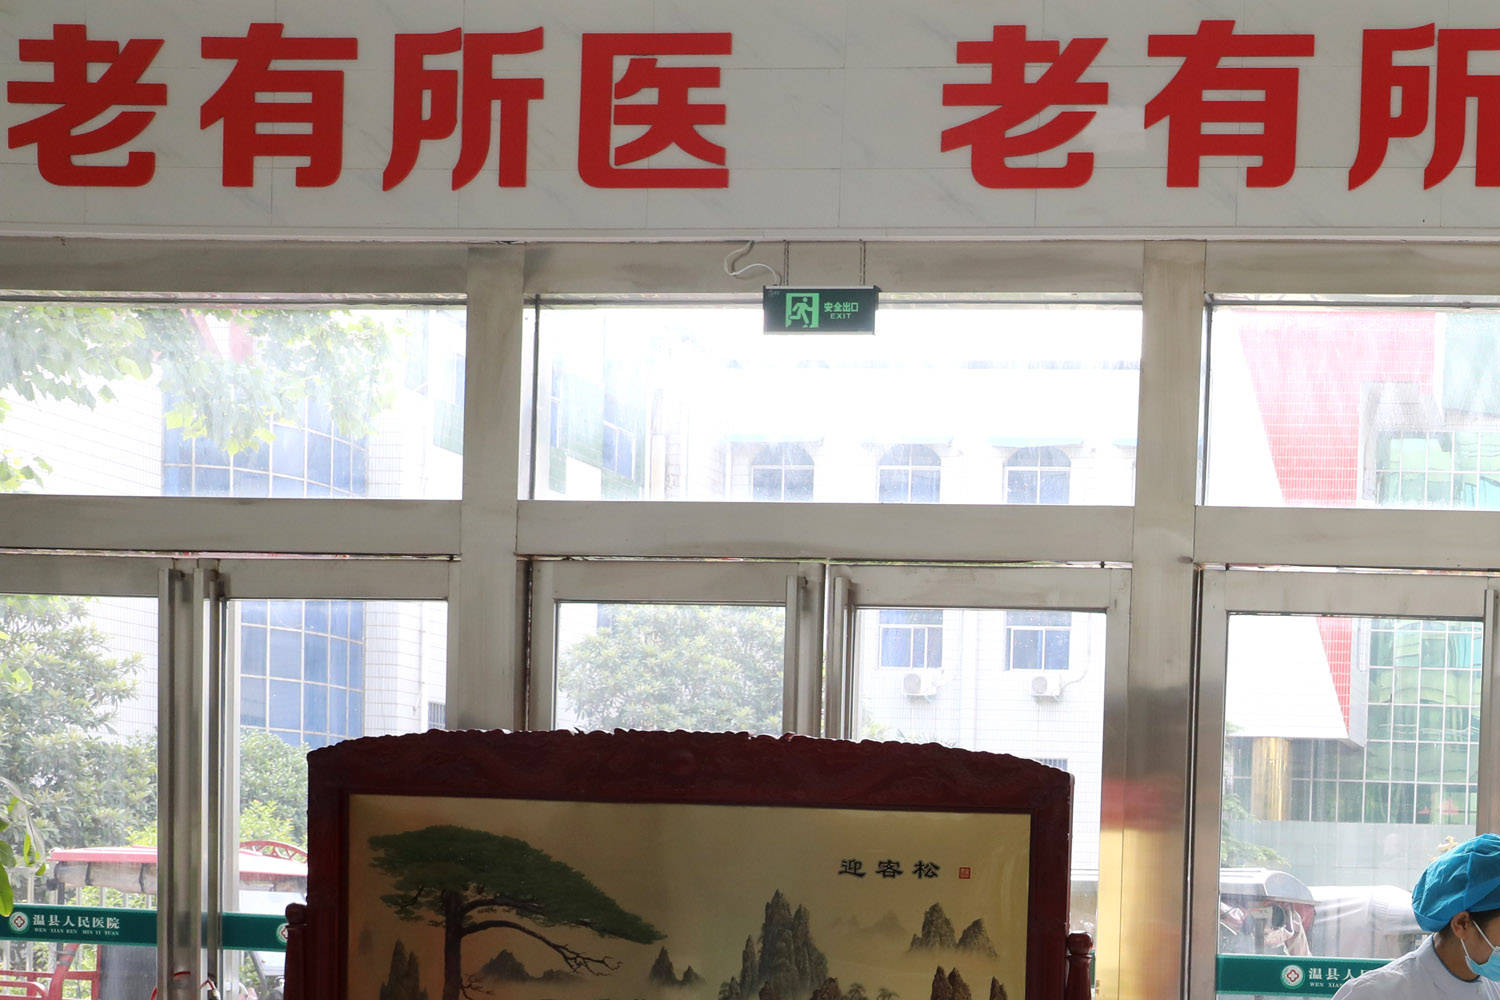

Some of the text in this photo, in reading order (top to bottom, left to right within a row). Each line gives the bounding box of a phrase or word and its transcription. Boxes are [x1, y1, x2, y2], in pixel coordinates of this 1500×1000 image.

[7, 22, 732, 191] 老有所医
[823, 301, 859, 313] 安全出口
[830, 312, 852, 320] EXIT
[837, 858, 941, 879] 迎客松
[32, 914, 121, 930] 温县人民医院
